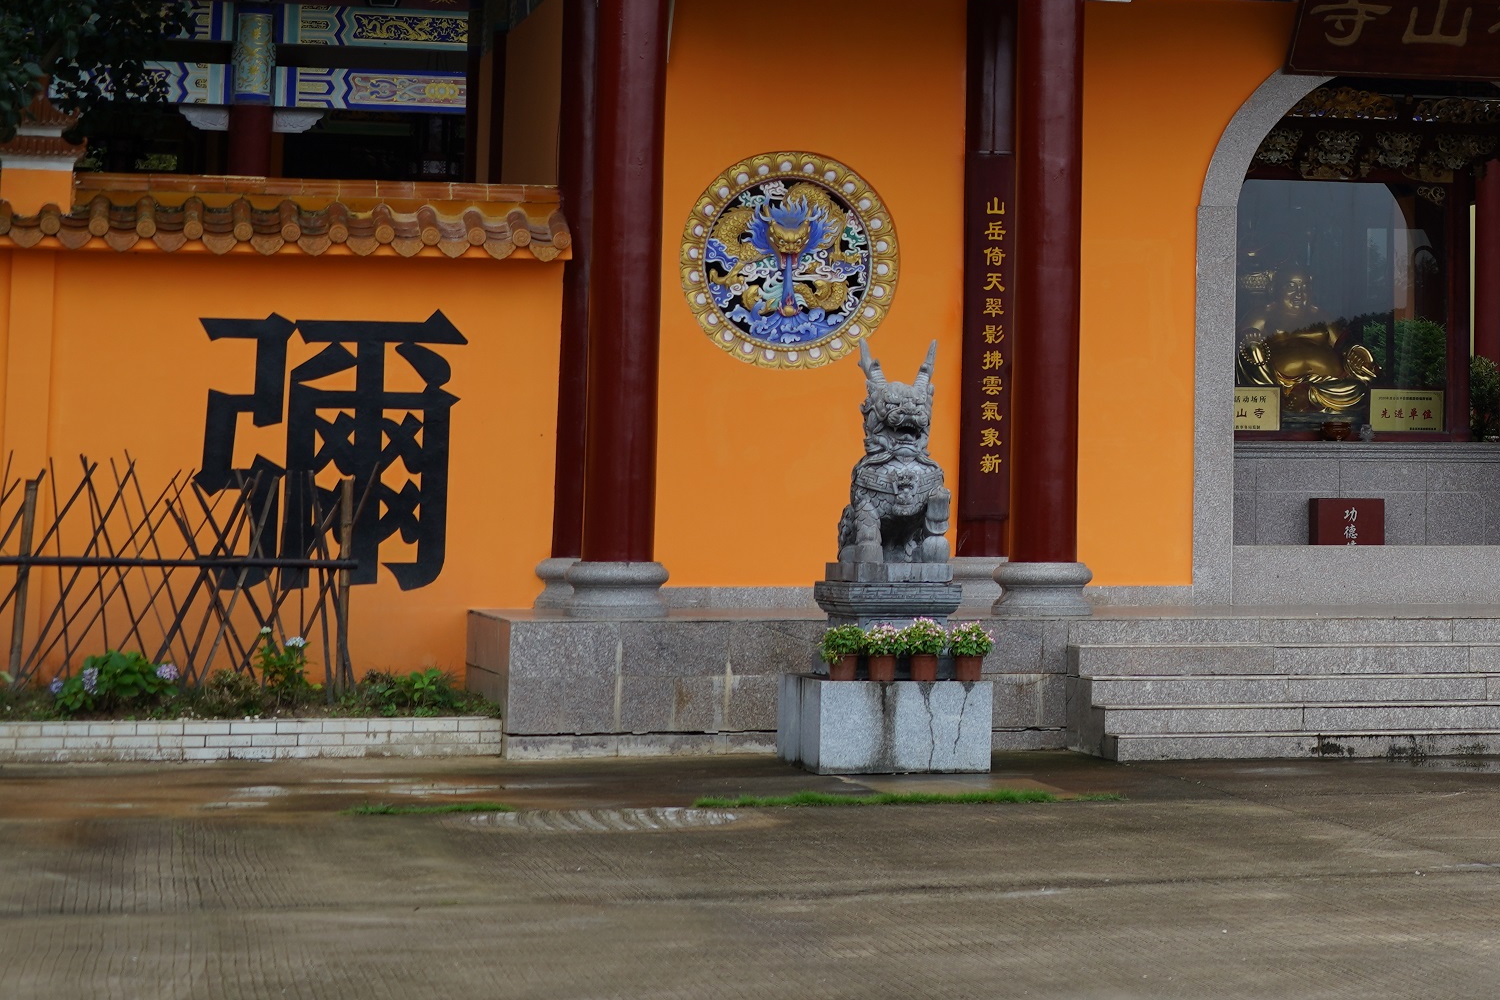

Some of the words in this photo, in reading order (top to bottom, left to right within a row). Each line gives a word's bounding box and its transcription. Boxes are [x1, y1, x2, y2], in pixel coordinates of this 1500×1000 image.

[980, 197, 1007, 474] 山岳倚天翠影拂雲氣象新
[1380, 407, 1433, 421] 先进单位
